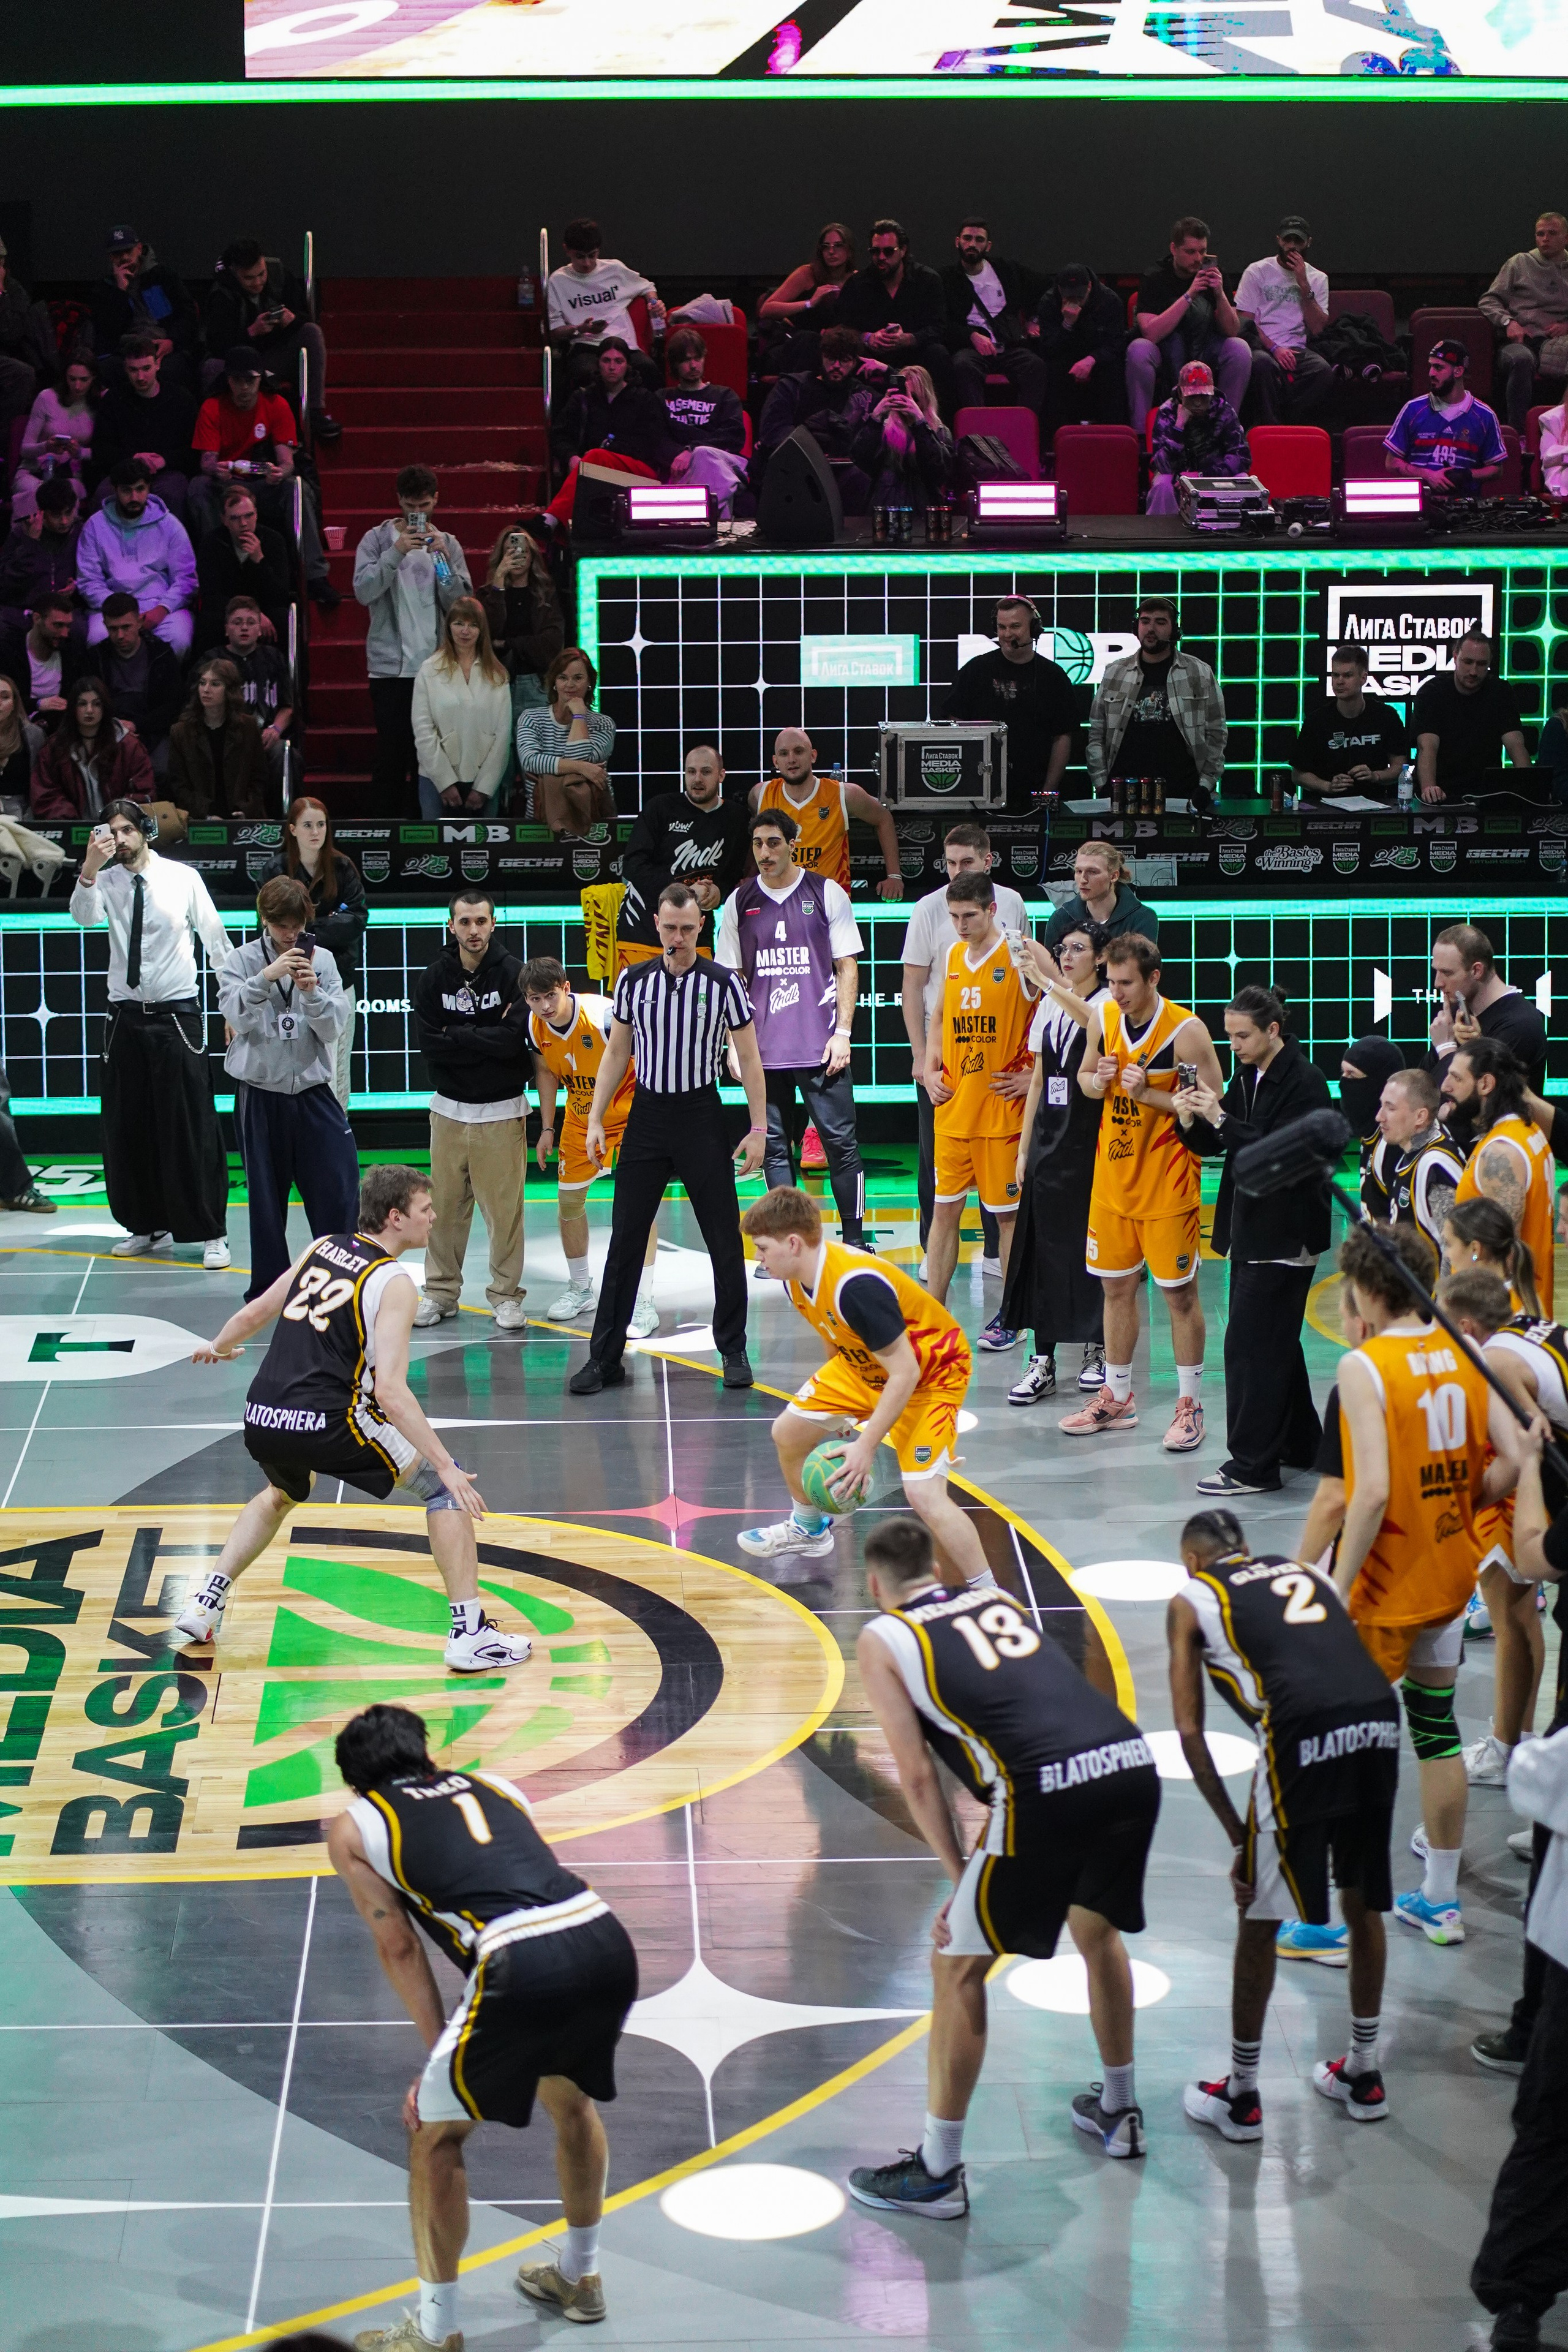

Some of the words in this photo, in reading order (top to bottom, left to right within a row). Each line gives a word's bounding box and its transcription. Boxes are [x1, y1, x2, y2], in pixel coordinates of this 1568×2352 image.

[1328, 734, 1381, 750] STAFF
[791, 847, 823, 863] STER
[1275, 846, 1320, 858] Basics
[1256, 857, 1312, 872] Winning
[775, 921, 787, 941] 4
[756, 946, 810, 968] MASTER
[783, 967, 811, 975] COLOR
[960, 987, 981, 1010] 25
[952, 1016, 997, 1034] MASTER
[315, 1240, 369, 1273] HARLEY
[282, 1265, 356, 1332] 22
[1416, 1382, 1467, 1451] 10
[1270, 1572, 1328, 1626] 2
[951, 1604, 1041, 1671] 13
[50, 1528, 225, 1855] BASKET
[1039, 1737, 1155, 1794] BLATOSPHER
[401, 1775, 472, 1800] THEO
[450, 1791, 493, 1845] 1
